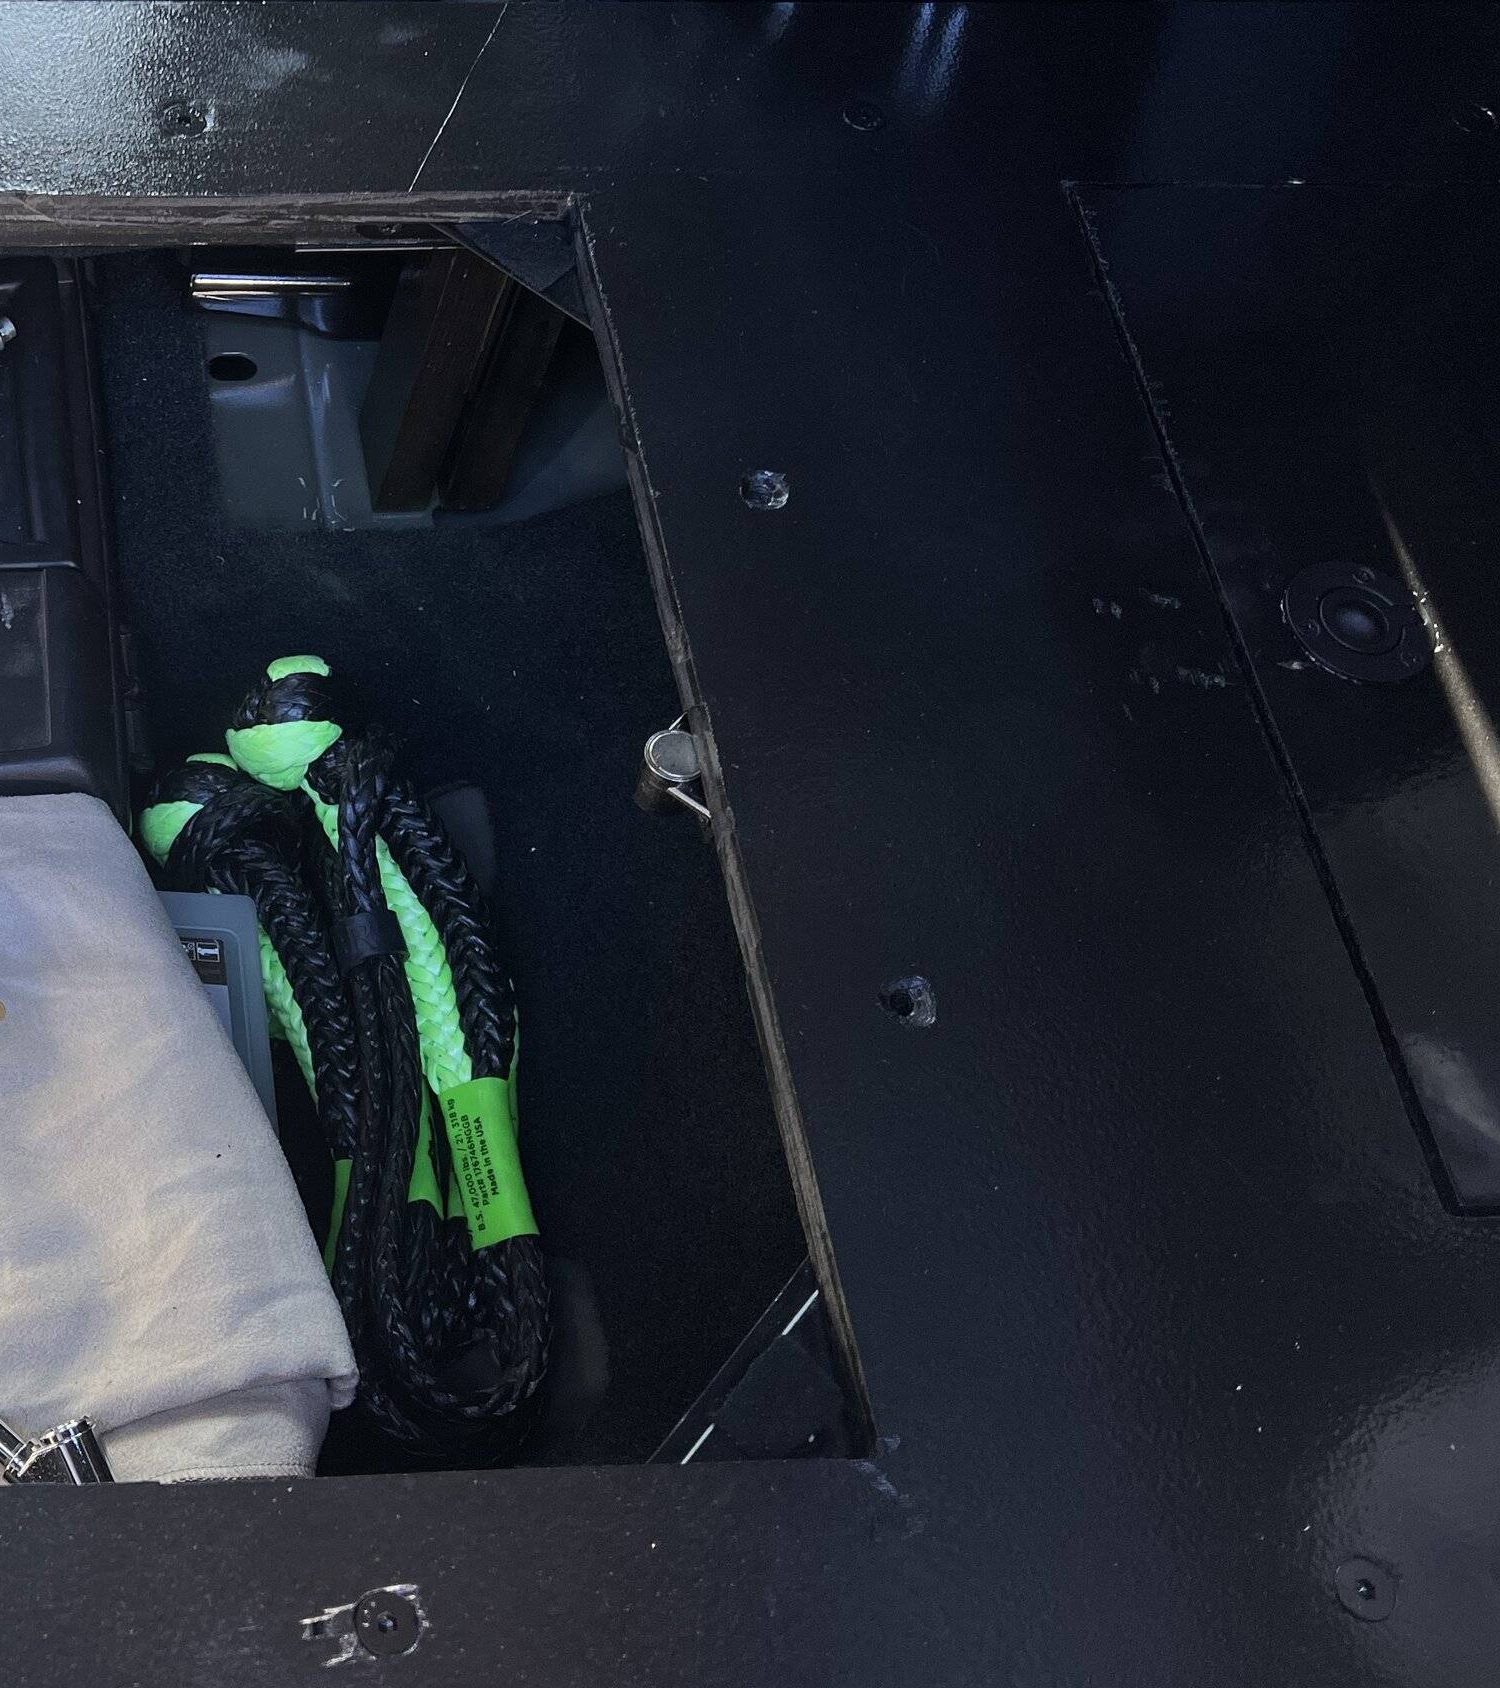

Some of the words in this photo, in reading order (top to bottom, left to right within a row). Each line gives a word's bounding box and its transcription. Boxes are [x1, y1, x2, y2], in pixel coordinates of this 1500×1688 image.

[473, 1116, 485, 1138] USA
[479, 1139, 489, 1156] the
[483, 1156, 492, 1167] in
[464, 1173, 480, 1208] 47,000
[486, 1168, 500, 1195] Made
